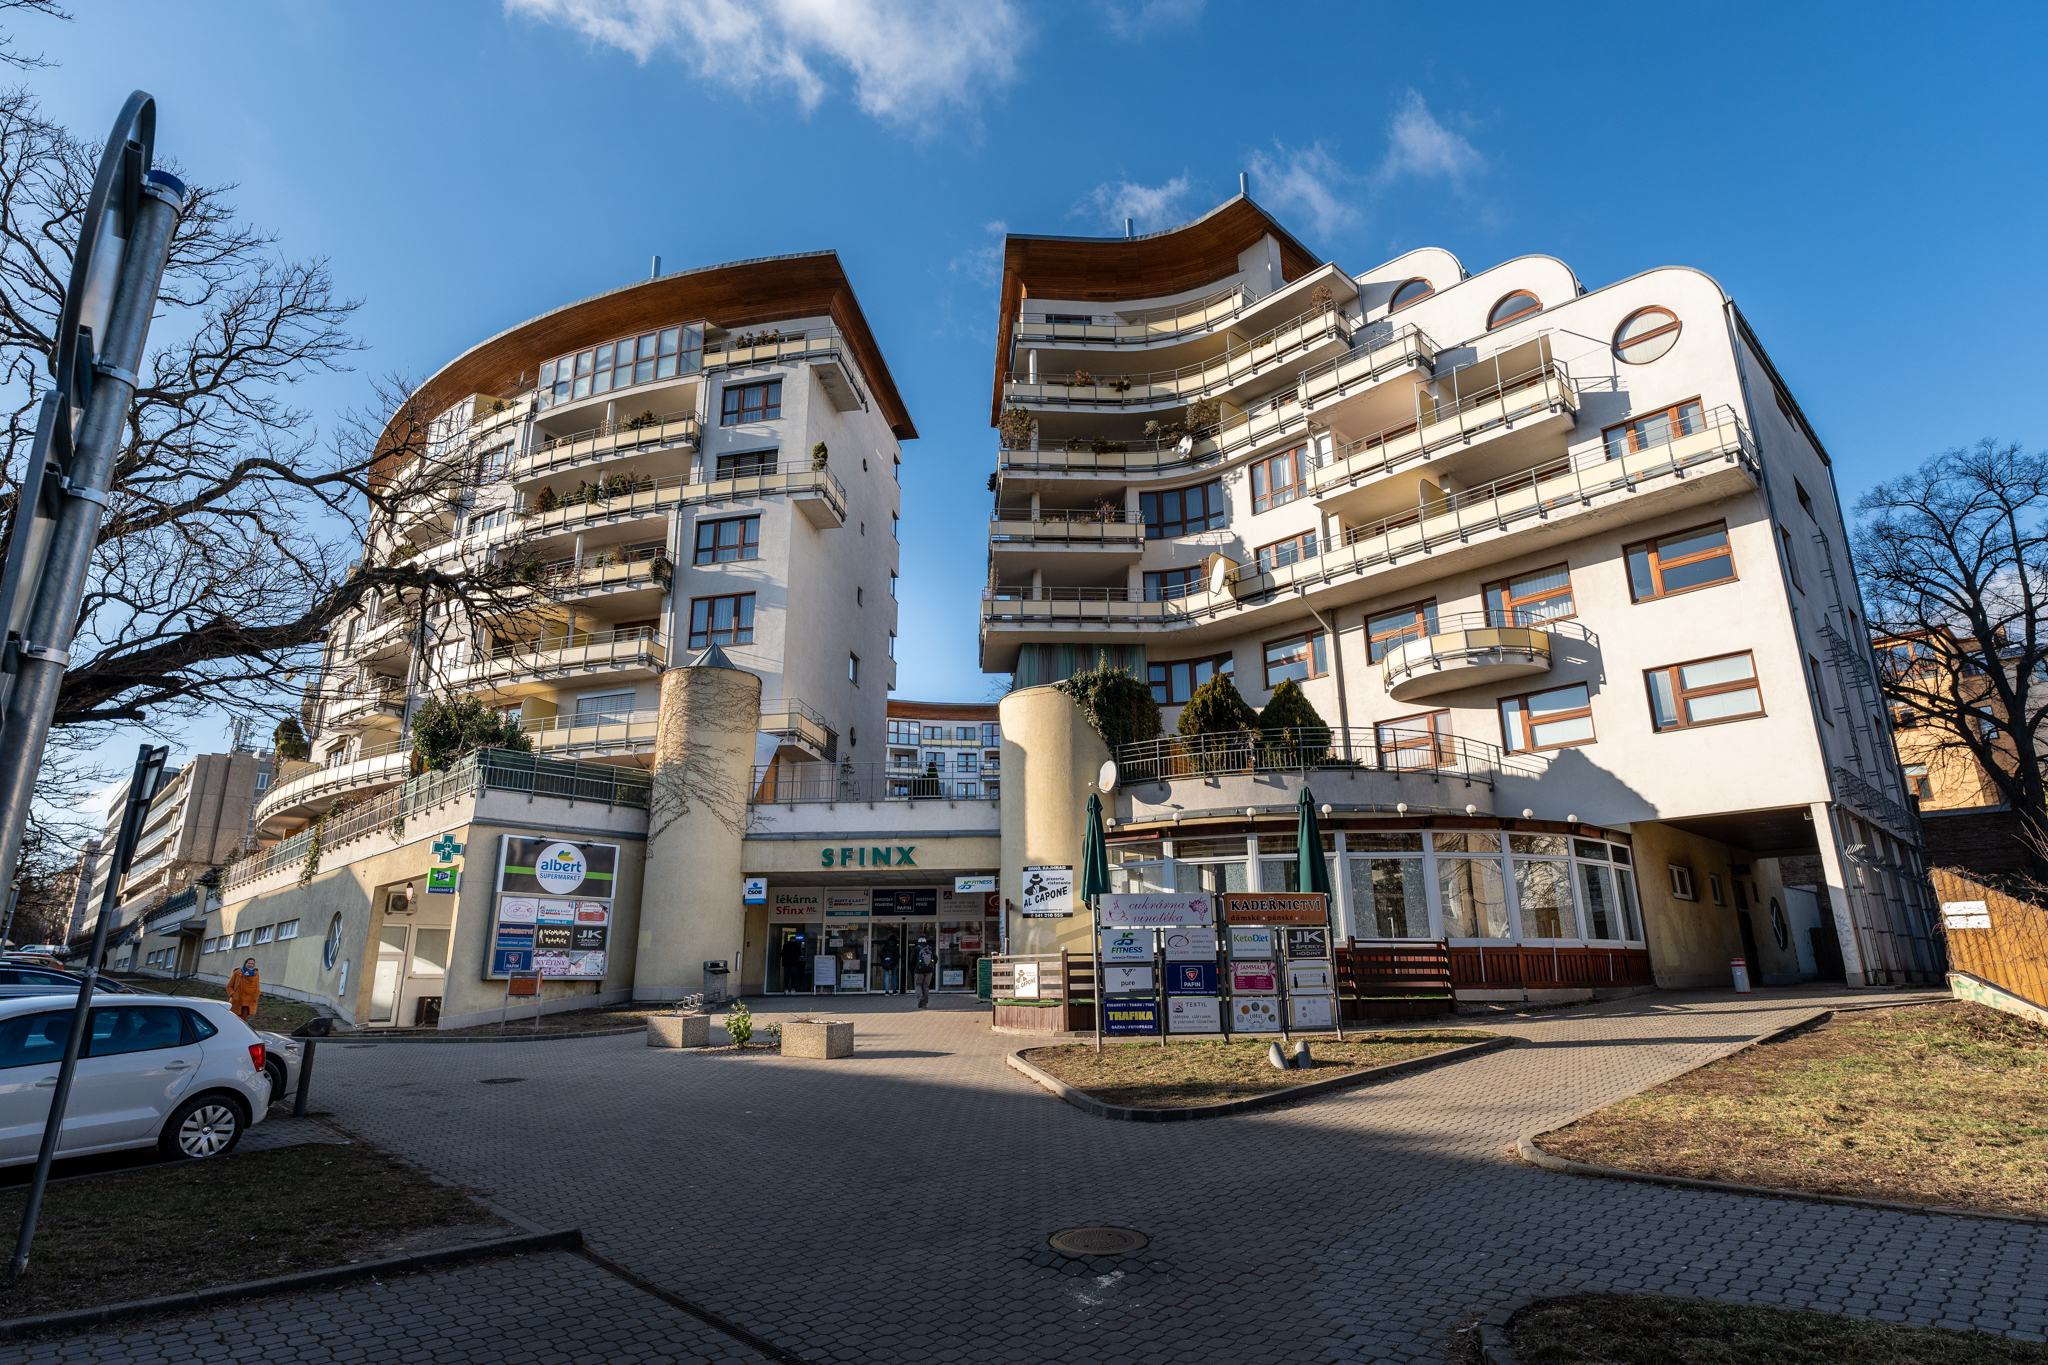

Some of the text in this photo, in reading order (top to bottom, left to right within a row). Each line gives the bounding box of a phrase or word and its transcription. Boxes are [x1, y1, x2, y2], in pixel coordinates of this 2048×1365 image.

[822, 847, 917, 867] SFINX
[540, 859, 581, 872] albert
[776, 894, 818, 904] lékárna
[1024, 886, 1067, 908] AL CAPONE
[1129, 897, 1186, 910] cukrárna
[1230, 897, 1321, 911] KADEŘNICTVÍ
[776, 906, 804, 914] Sfinx
[1132, 910, 1184, 922] vinotéka
[577, 930, 602, 938] JK
[1234, 934, 1268, 942] KetoDiet
[1290, 931, 1324, 943] JK
[1021, 977, 1036, 988] CAPONE
[1108, 1011, 1154, 1020] TRAFIKA
